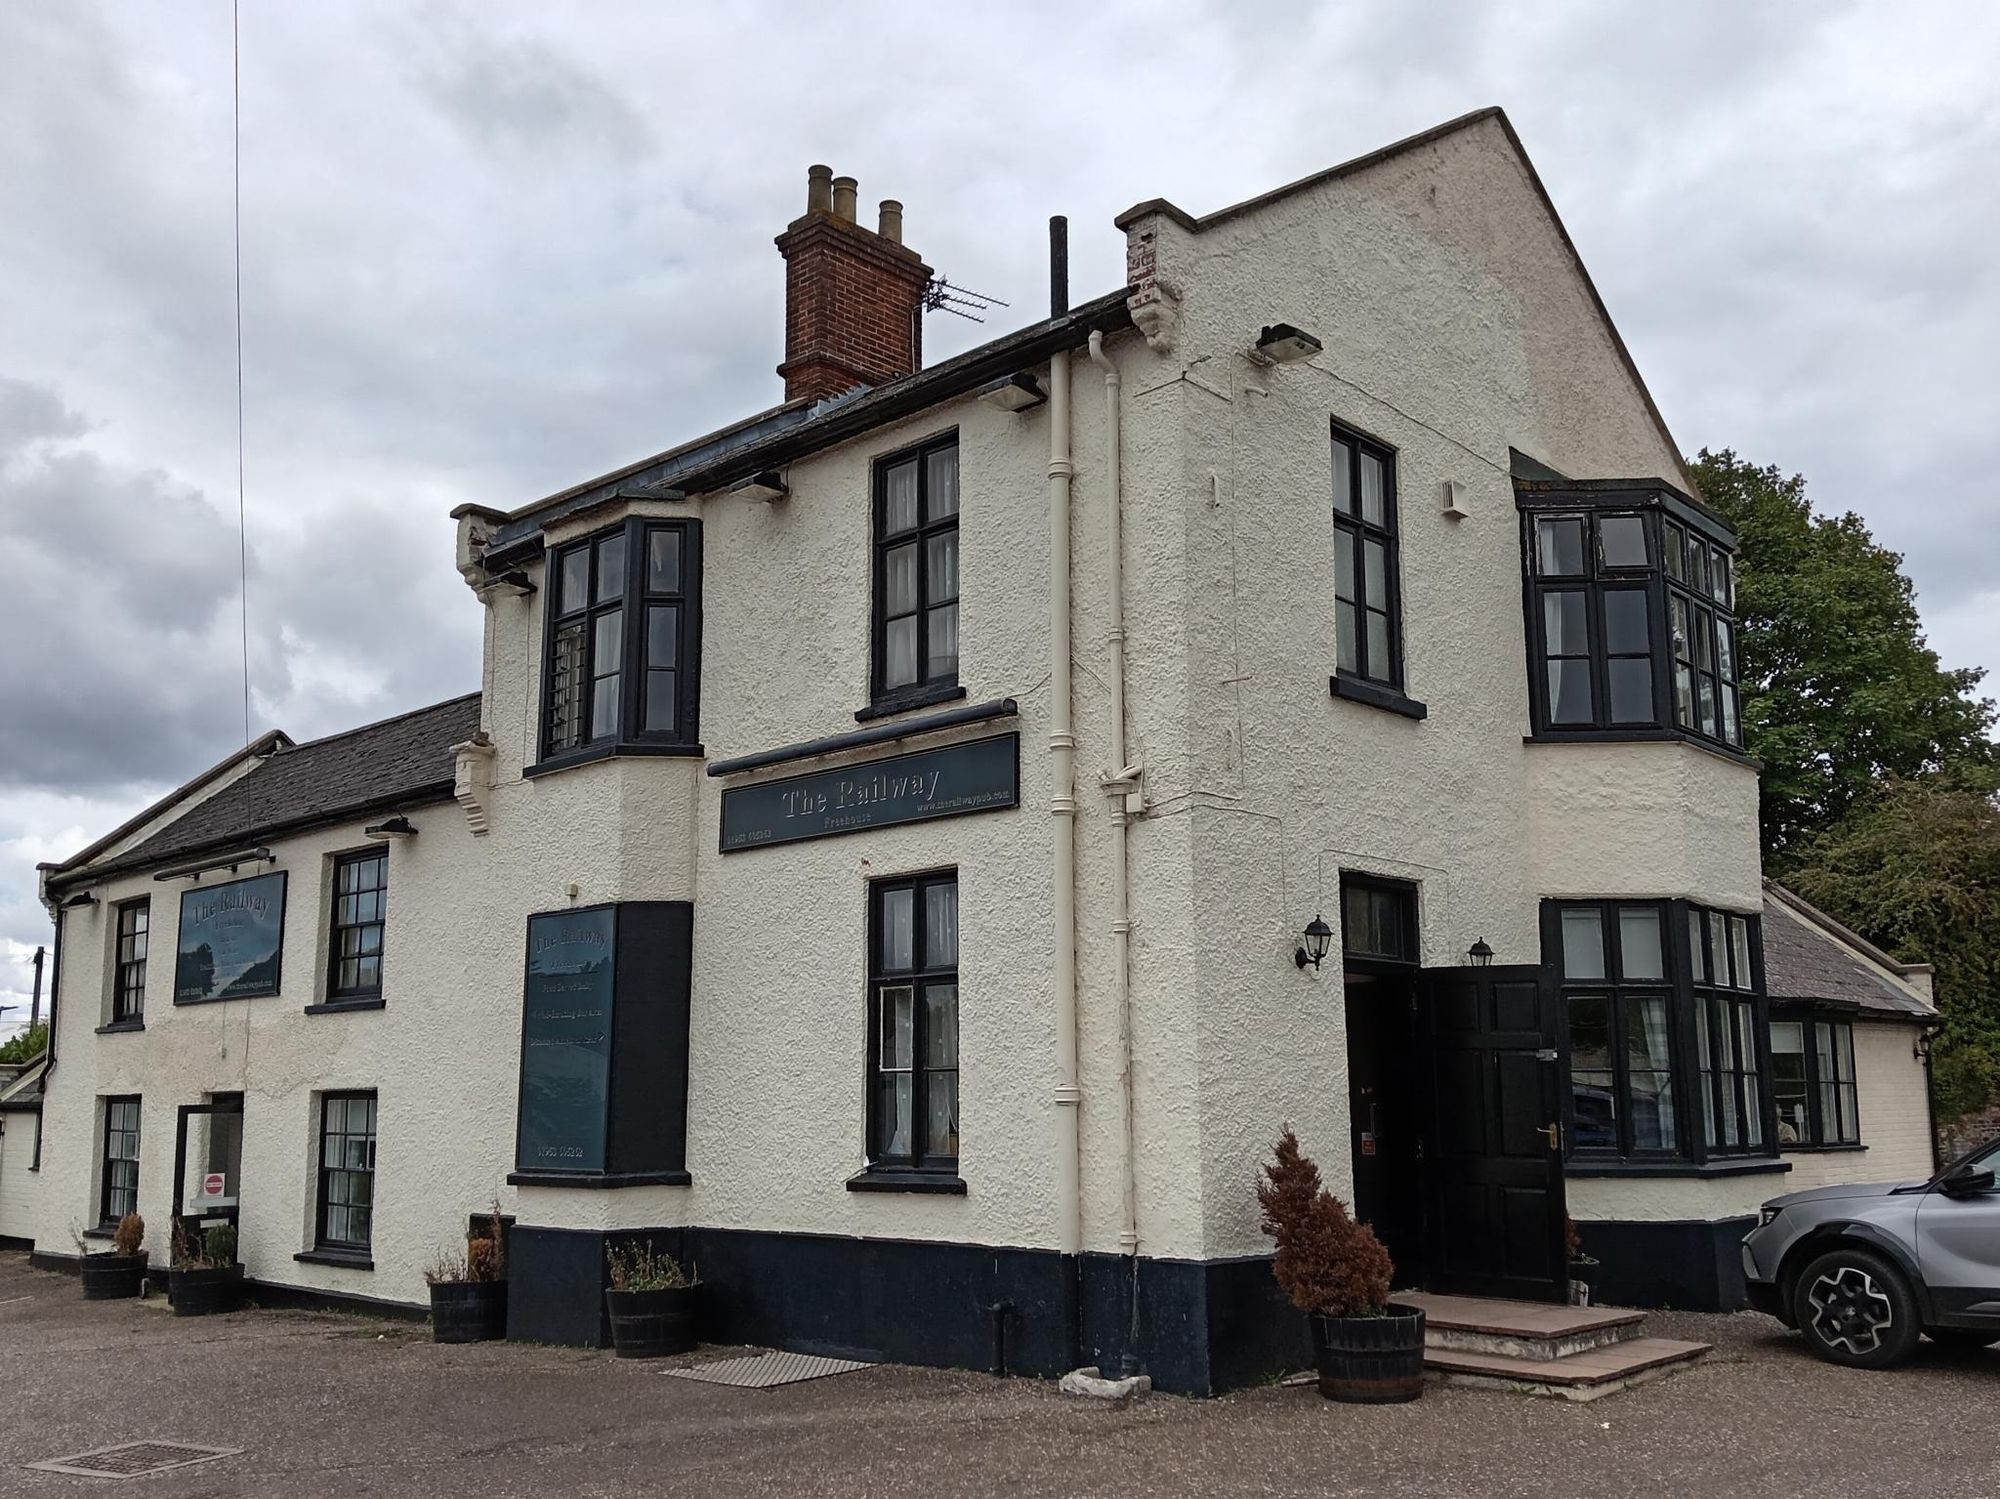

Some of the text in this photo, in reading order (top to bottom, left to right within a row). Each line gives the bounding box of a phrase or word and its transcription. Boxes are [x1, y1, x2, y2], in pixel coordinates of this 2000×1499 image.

[781, 770, 940, 818] The Railway
[823, 812, 872, 829] Freehouse
[193, 901, 217, 927] The
[220, 889, 271, 920] Railway
[536, 928, 609, 954] The Railway
